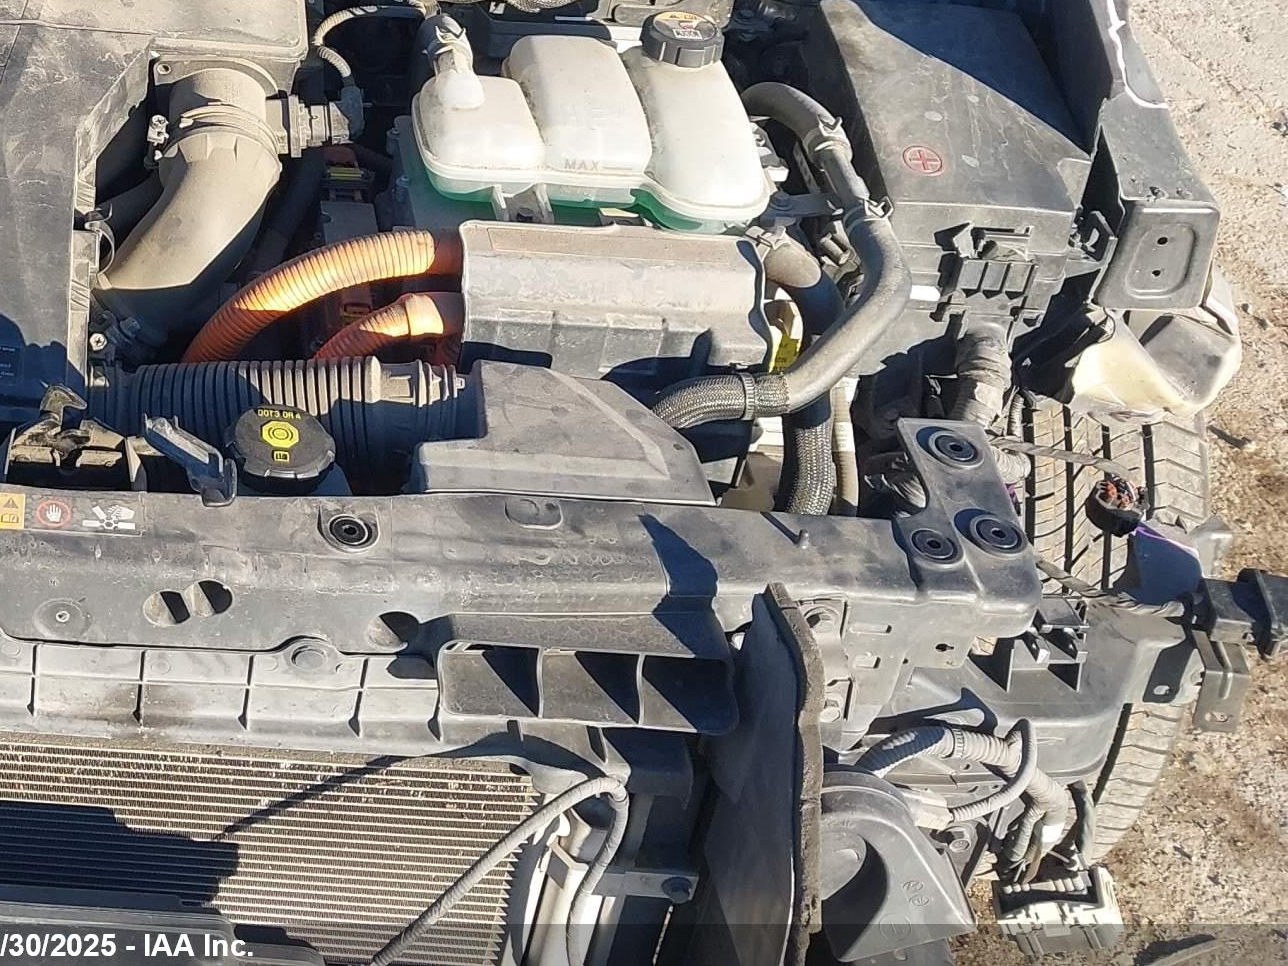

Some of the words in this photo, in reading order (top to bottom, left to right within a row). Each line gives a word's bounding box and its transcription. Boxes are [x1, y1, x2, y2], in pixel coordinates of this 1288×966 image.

[564, 158, 601, 171] MAX
[257, 409, 280, 418] DOT3
[282, 410, 294, 419] OR
